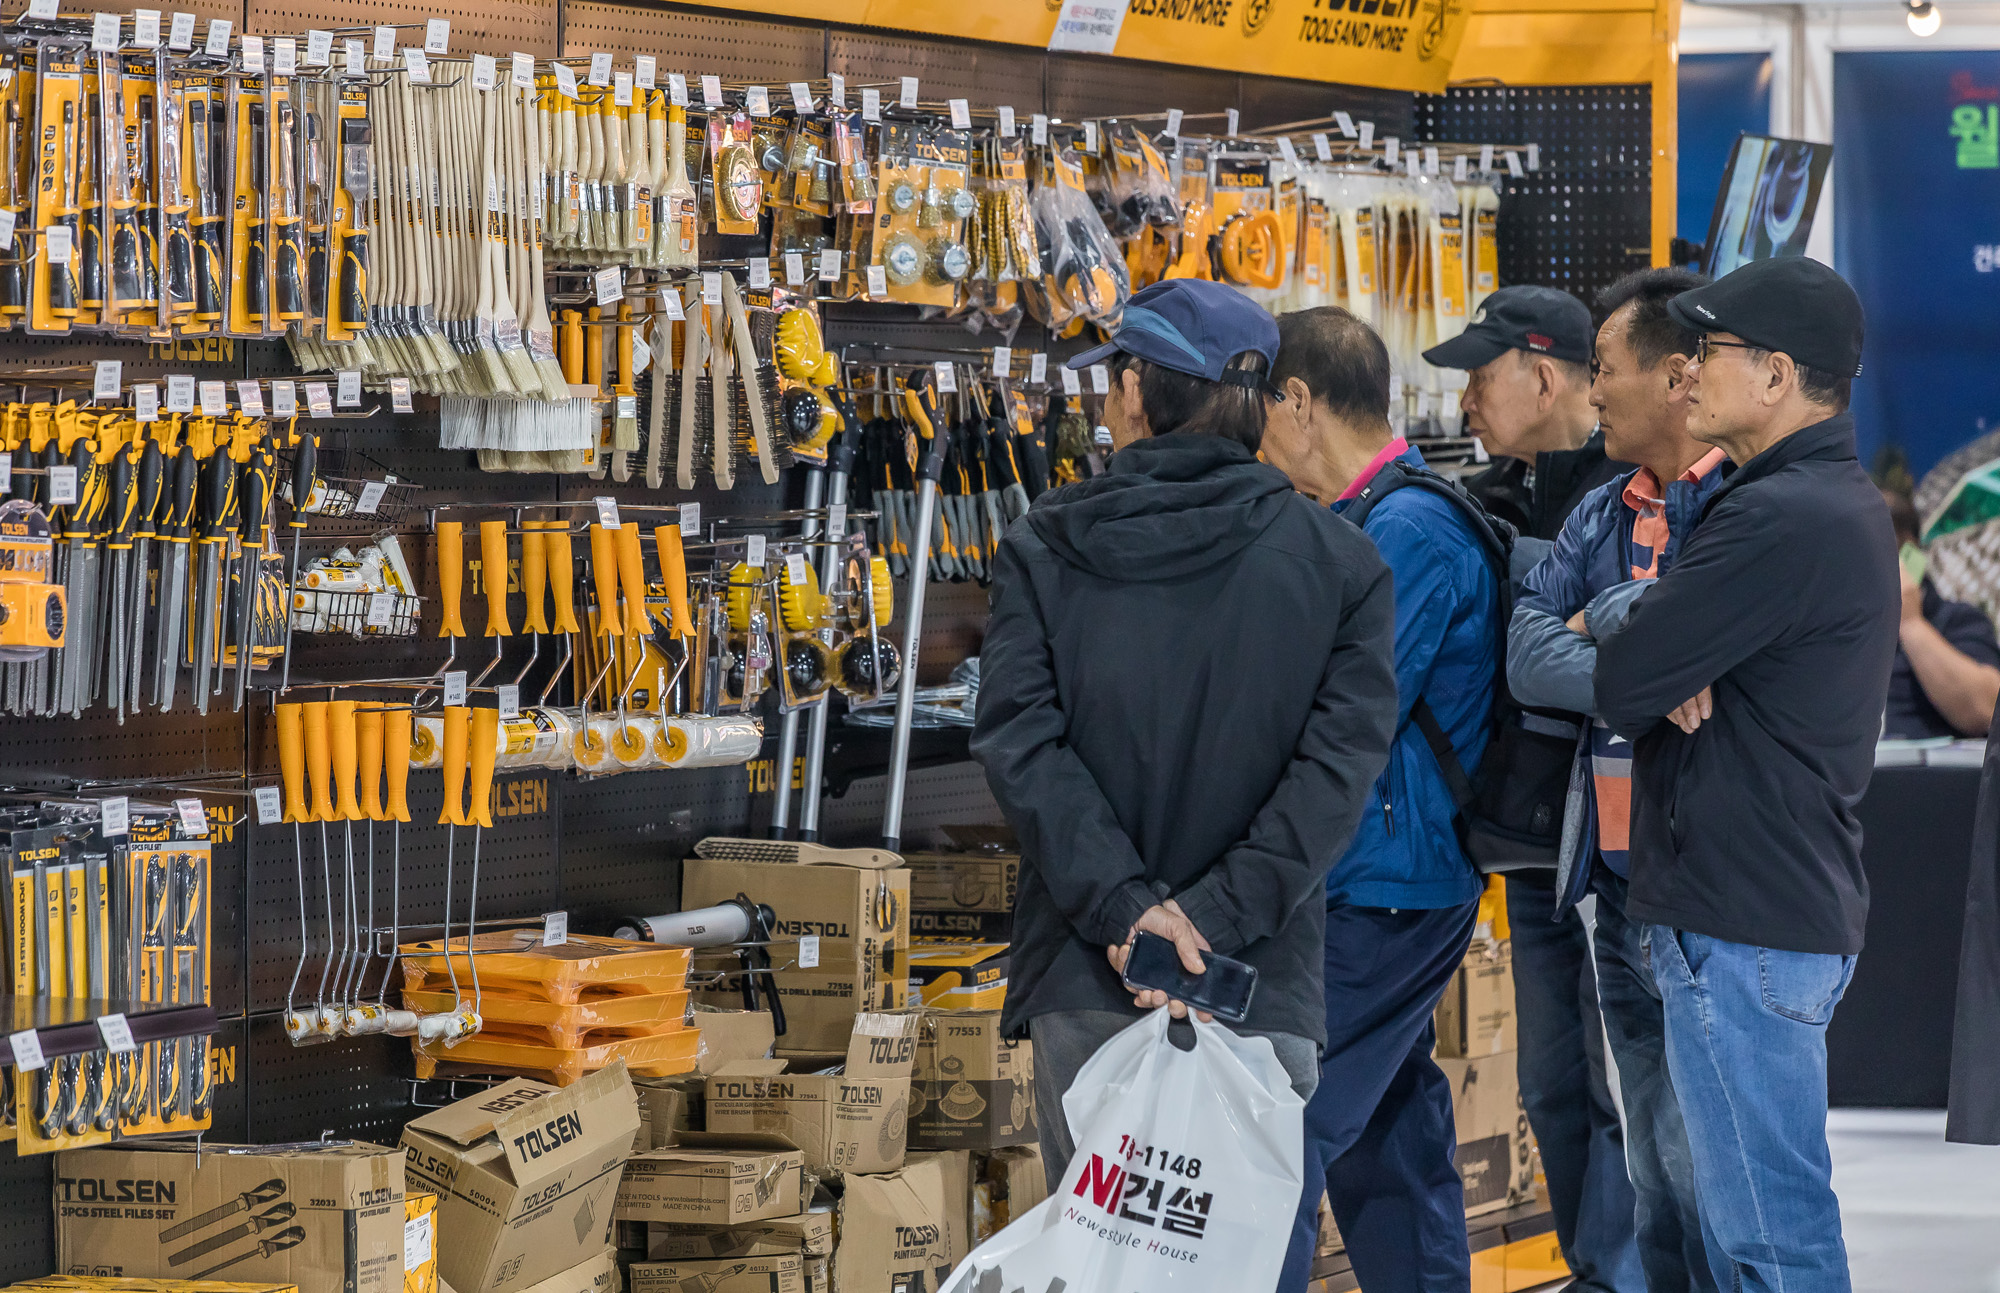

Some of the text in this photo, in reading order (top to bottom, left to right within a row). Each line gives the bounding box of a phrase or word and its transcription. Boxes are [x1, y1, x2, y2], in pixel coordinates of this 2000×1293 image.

[1188, 0, 1232, 27] MORE
[1299, 15, 1408, 52] TOOLS AND MORE
[49, 62, 80, 72] TOLSEN
[128, 65, 156, 75] TOLSE
[243, 79, 265, 89] TOLSE
[342, 92, 368, 101] TOLSEN
[756, 117, 789, 127] TOLSEN
[915, 144, 967, 163] TOLSEN
[1221, 173, 1263, 187] TOLSEN
[352, 290, 367, 319] TOLSEN
[747, 293, 772, 306] TOLSEN
[2, 523, 29, 536] TOLSEN
[910, 637, 919, 670] TOLSEN
[490, 778, 548, 817] OLSEN
[131, 827, 170, 842] TOLSEN
[19, 847, 60, 862] TOLSEN
[777, 921, 850, 938] TOLSEN
[911, 914, 982, 931] TOLSEN
[687, 925, 706, 936] TOLSEN
[976, 967, 1001, 984] TOLSEN
[811, 989, 838, 997] BRUSH
[827, 982, 853, 990] 77554
[948, 1027, 982, 1037] 77553
[869, 1036, 916, 1064] TOLSEN
[715, 1083, 794, 1098] TOLSEN
[839, 1085, 883, 1105] TOLSEN
[514, 1110, 583, 1164] TOLSEN
[735, 1164, 756, 1174] TOLSEN
[59, 1178, 176, 1203] TOLSEN
[359, 1187, 392, 1207] TOLSEN
[416, 1180, 449, 1202] BRUSHES
[469, 1189, 496, 1207] 50004
[521, 1179, 566, 1213] TOLSEN
[309, 1199, 336, 1207] 32033
[662, 1196, 726, 1205] www.tolsentools.com
[61, 1207, 176, 1220] 3PCS STEEL FILES SET
[514, 1204, 554, 1230] CEILING BRUSHES
[895, 1224, 939, 1248] TOLSEN
[1065, 1206, 1199, 1263] Newestyle House
[894, 1250, 910, 1260] PAINT
[780, 1260, 796, 1269] TOLSEN
[637, 1268, 677, 1277] TOLSEN
